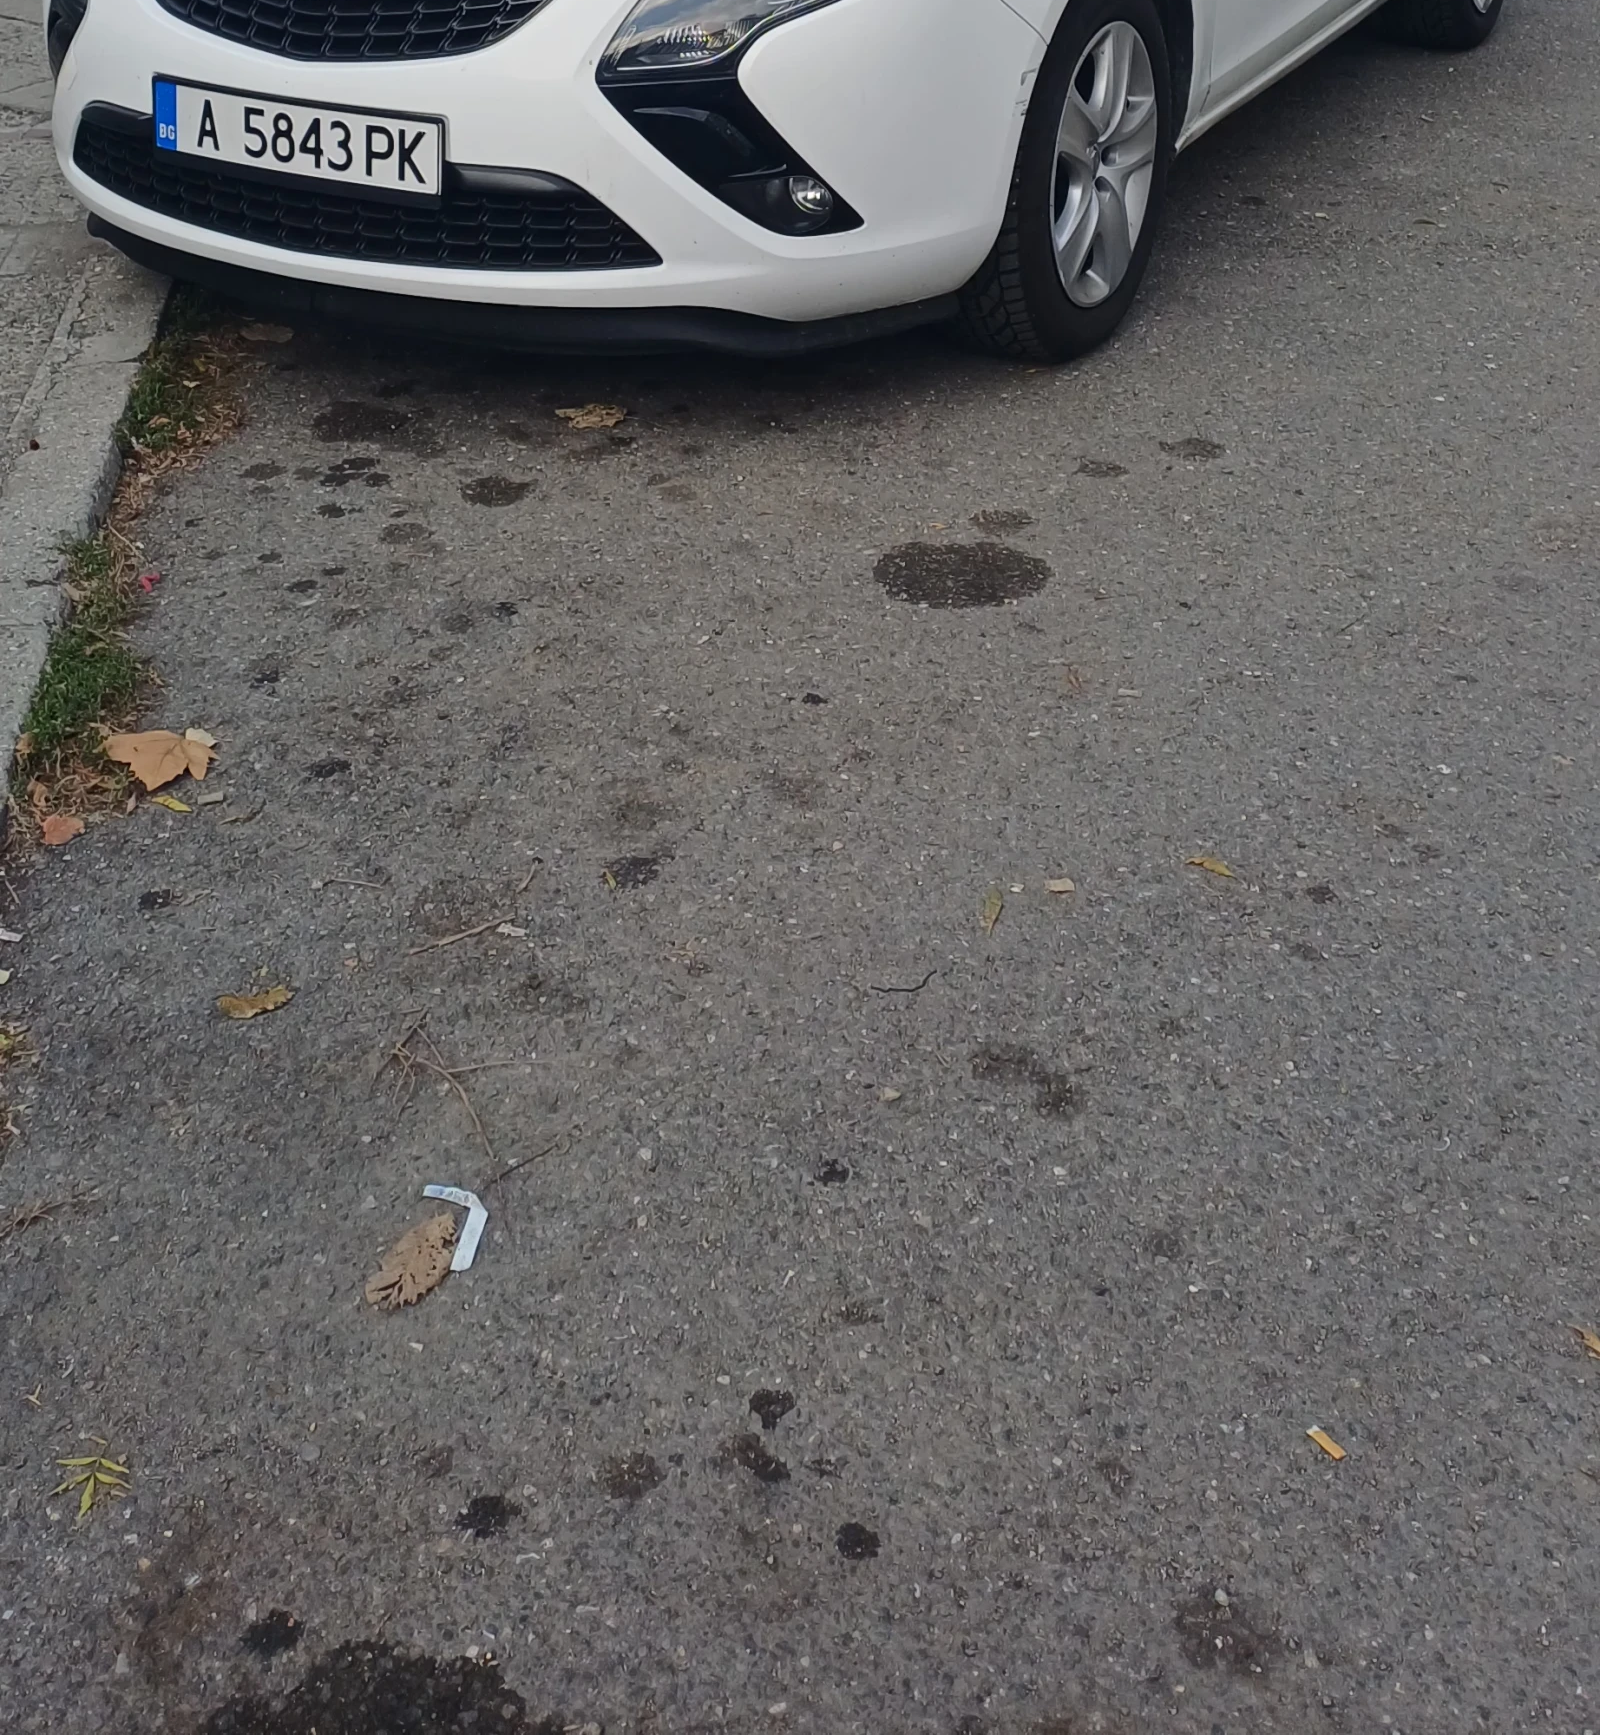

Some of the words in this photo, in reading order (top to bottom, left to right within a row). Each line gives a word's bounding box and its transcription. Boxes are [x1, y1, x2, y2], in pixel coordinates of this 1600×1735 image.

[159, 122, 176, 141] BG
[197, 99, 220, 151] A
[244, 106, 353, 172] 5843
[366, 124, 426, 184] PK
